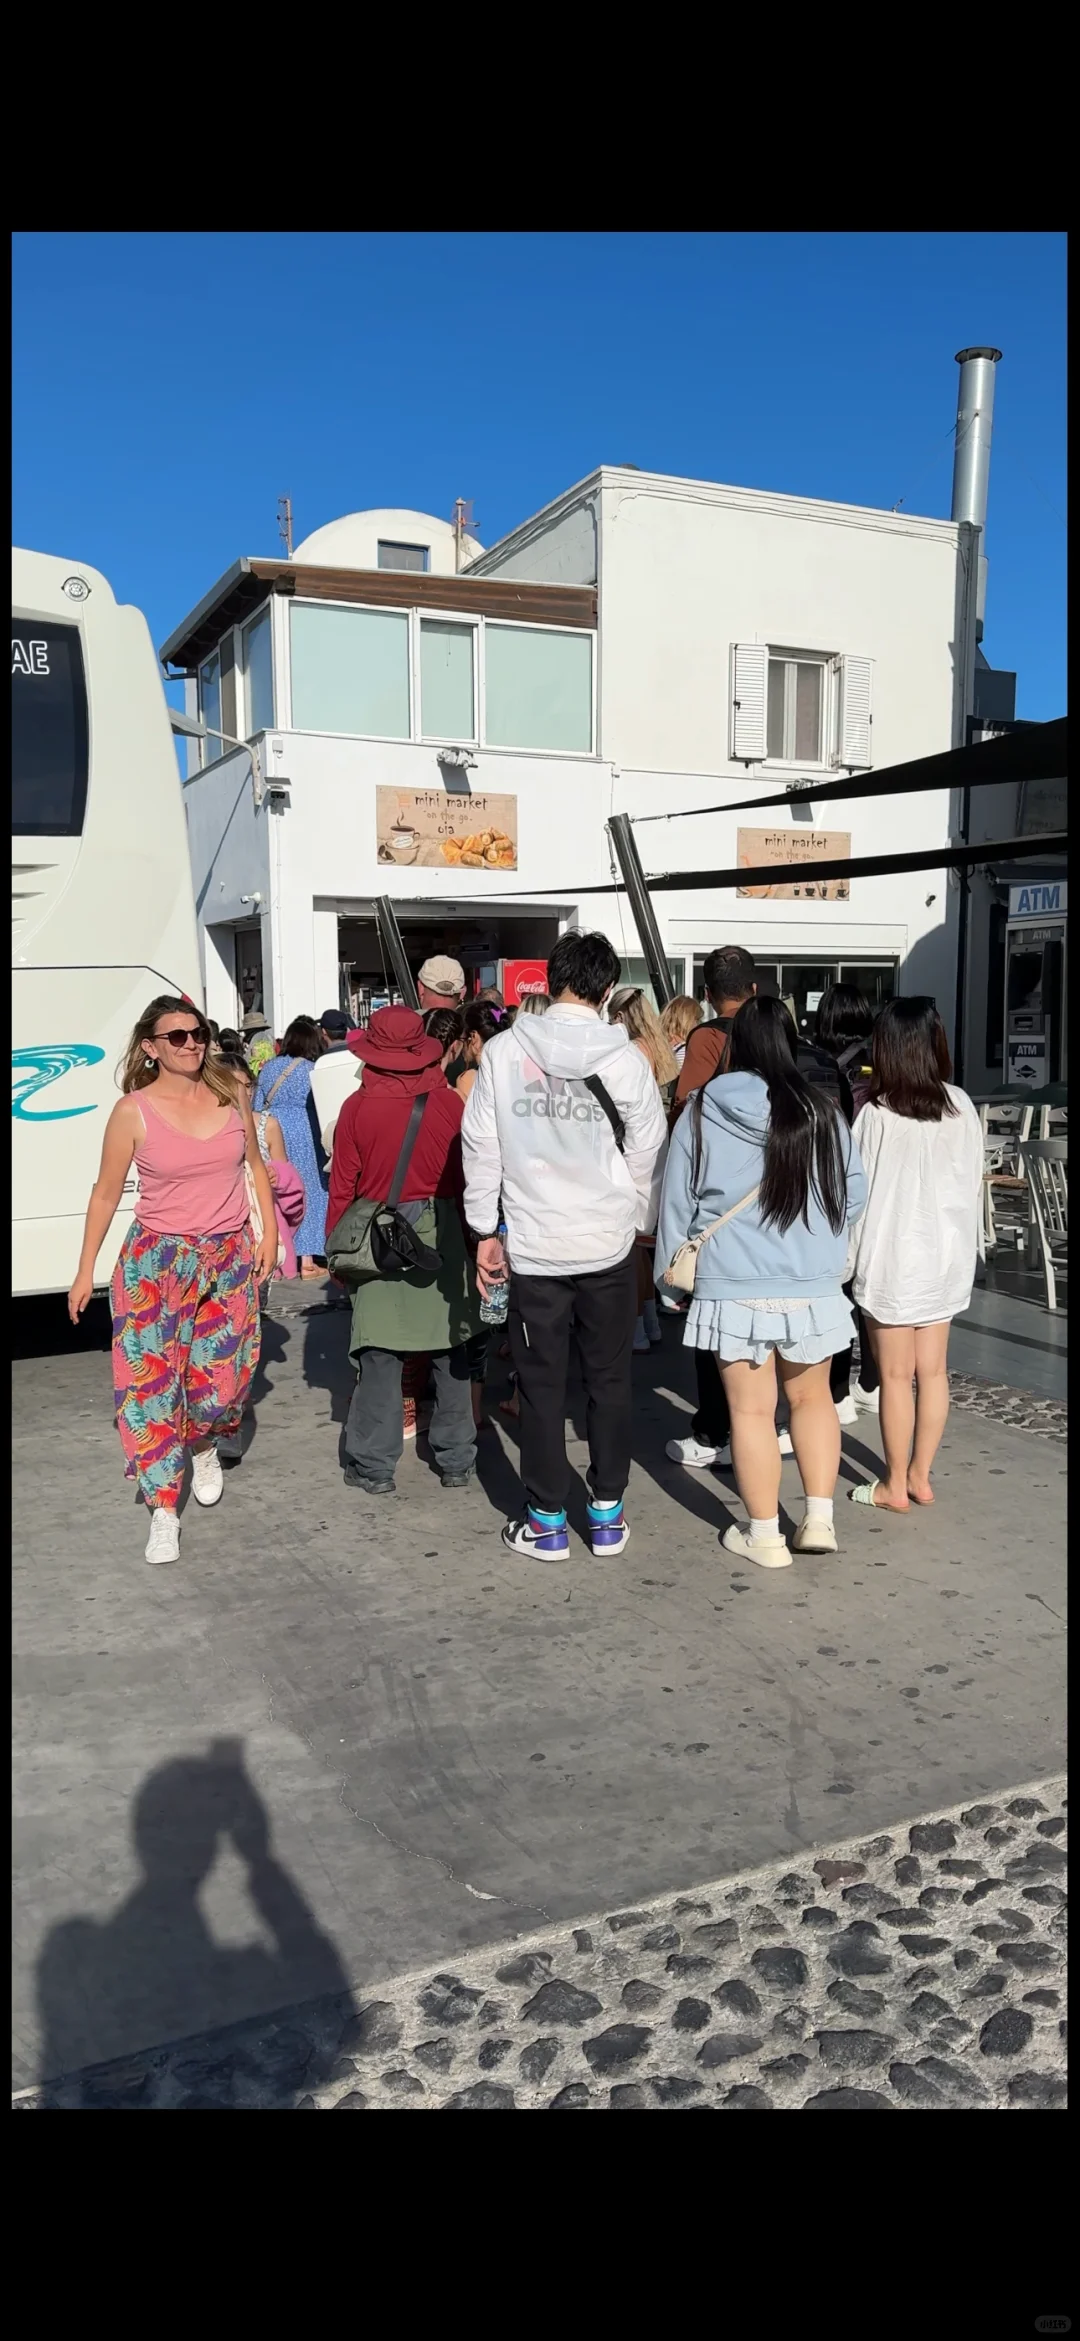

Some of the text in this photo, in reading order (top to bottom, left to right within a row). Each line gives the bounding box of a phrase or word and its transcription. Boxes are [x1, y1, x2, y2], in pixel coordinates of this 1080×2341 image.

[415, 791, 488, 811] mini market
[440, 807, 455, 821] the
[437, 821, 455, 836] oia
[764, 833, 828, 850] mini market
[1017, 885, 1061, 913] ATM
[1032, 929, 1052, 941] ATM
[516, 981, 547, 993] Coca-Cola
[1016, 1044, 1037, 1056] ATM
[511, 1092, 606, 1123] adidas
